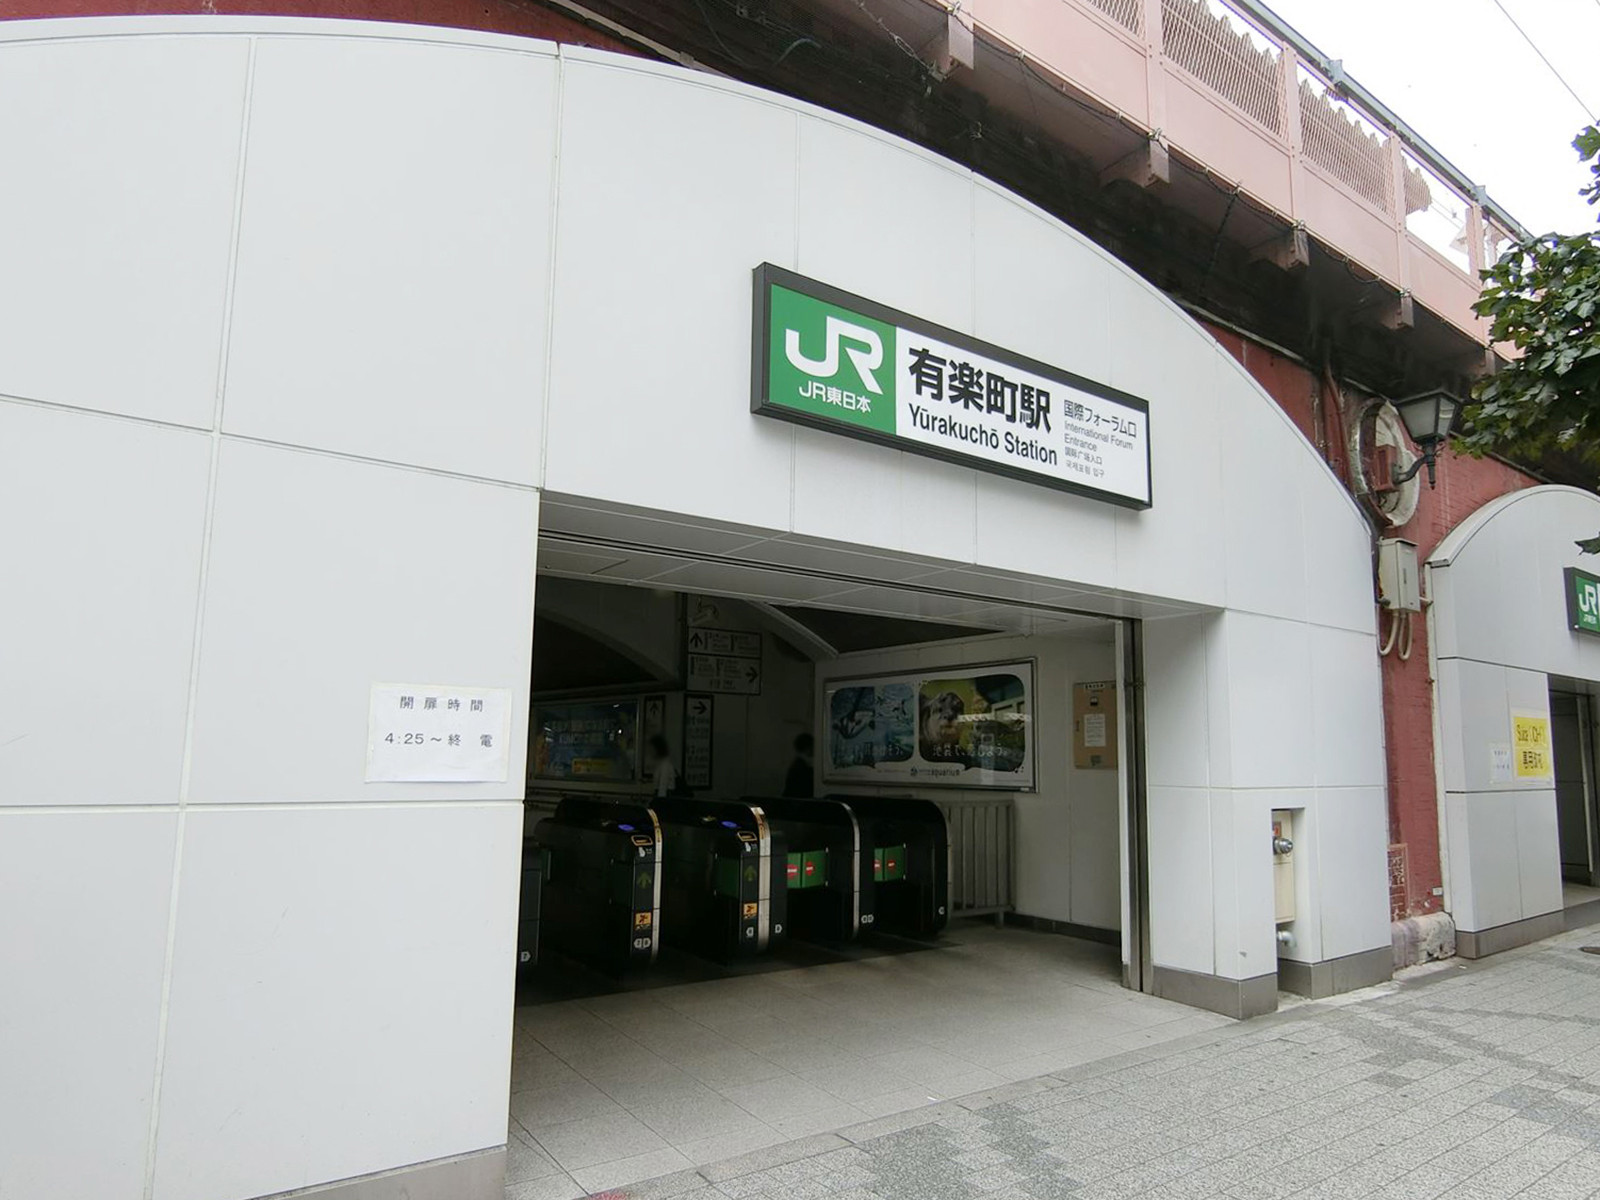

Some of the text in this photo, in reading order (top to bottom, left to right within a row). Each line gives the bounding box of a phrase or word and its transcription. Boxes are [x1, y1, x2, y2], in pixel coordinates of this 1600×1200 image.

[785, 315, 884, 395] JR
[798, 380, 872, 414] JR東日本
[908, 347, 1052, 434] 有楽町駅
[908, 402, 1058, 466] Yūrakuchō Station
[1064, 399, 1137, 438] 国際フォーラム口
[1064, 420, 1134, 451] International Forum
[1064, 433, 1098, 452] Entrance
[1578, 584, 1598, 616] JR
[399, 696, 484, 712] 開扉時間
